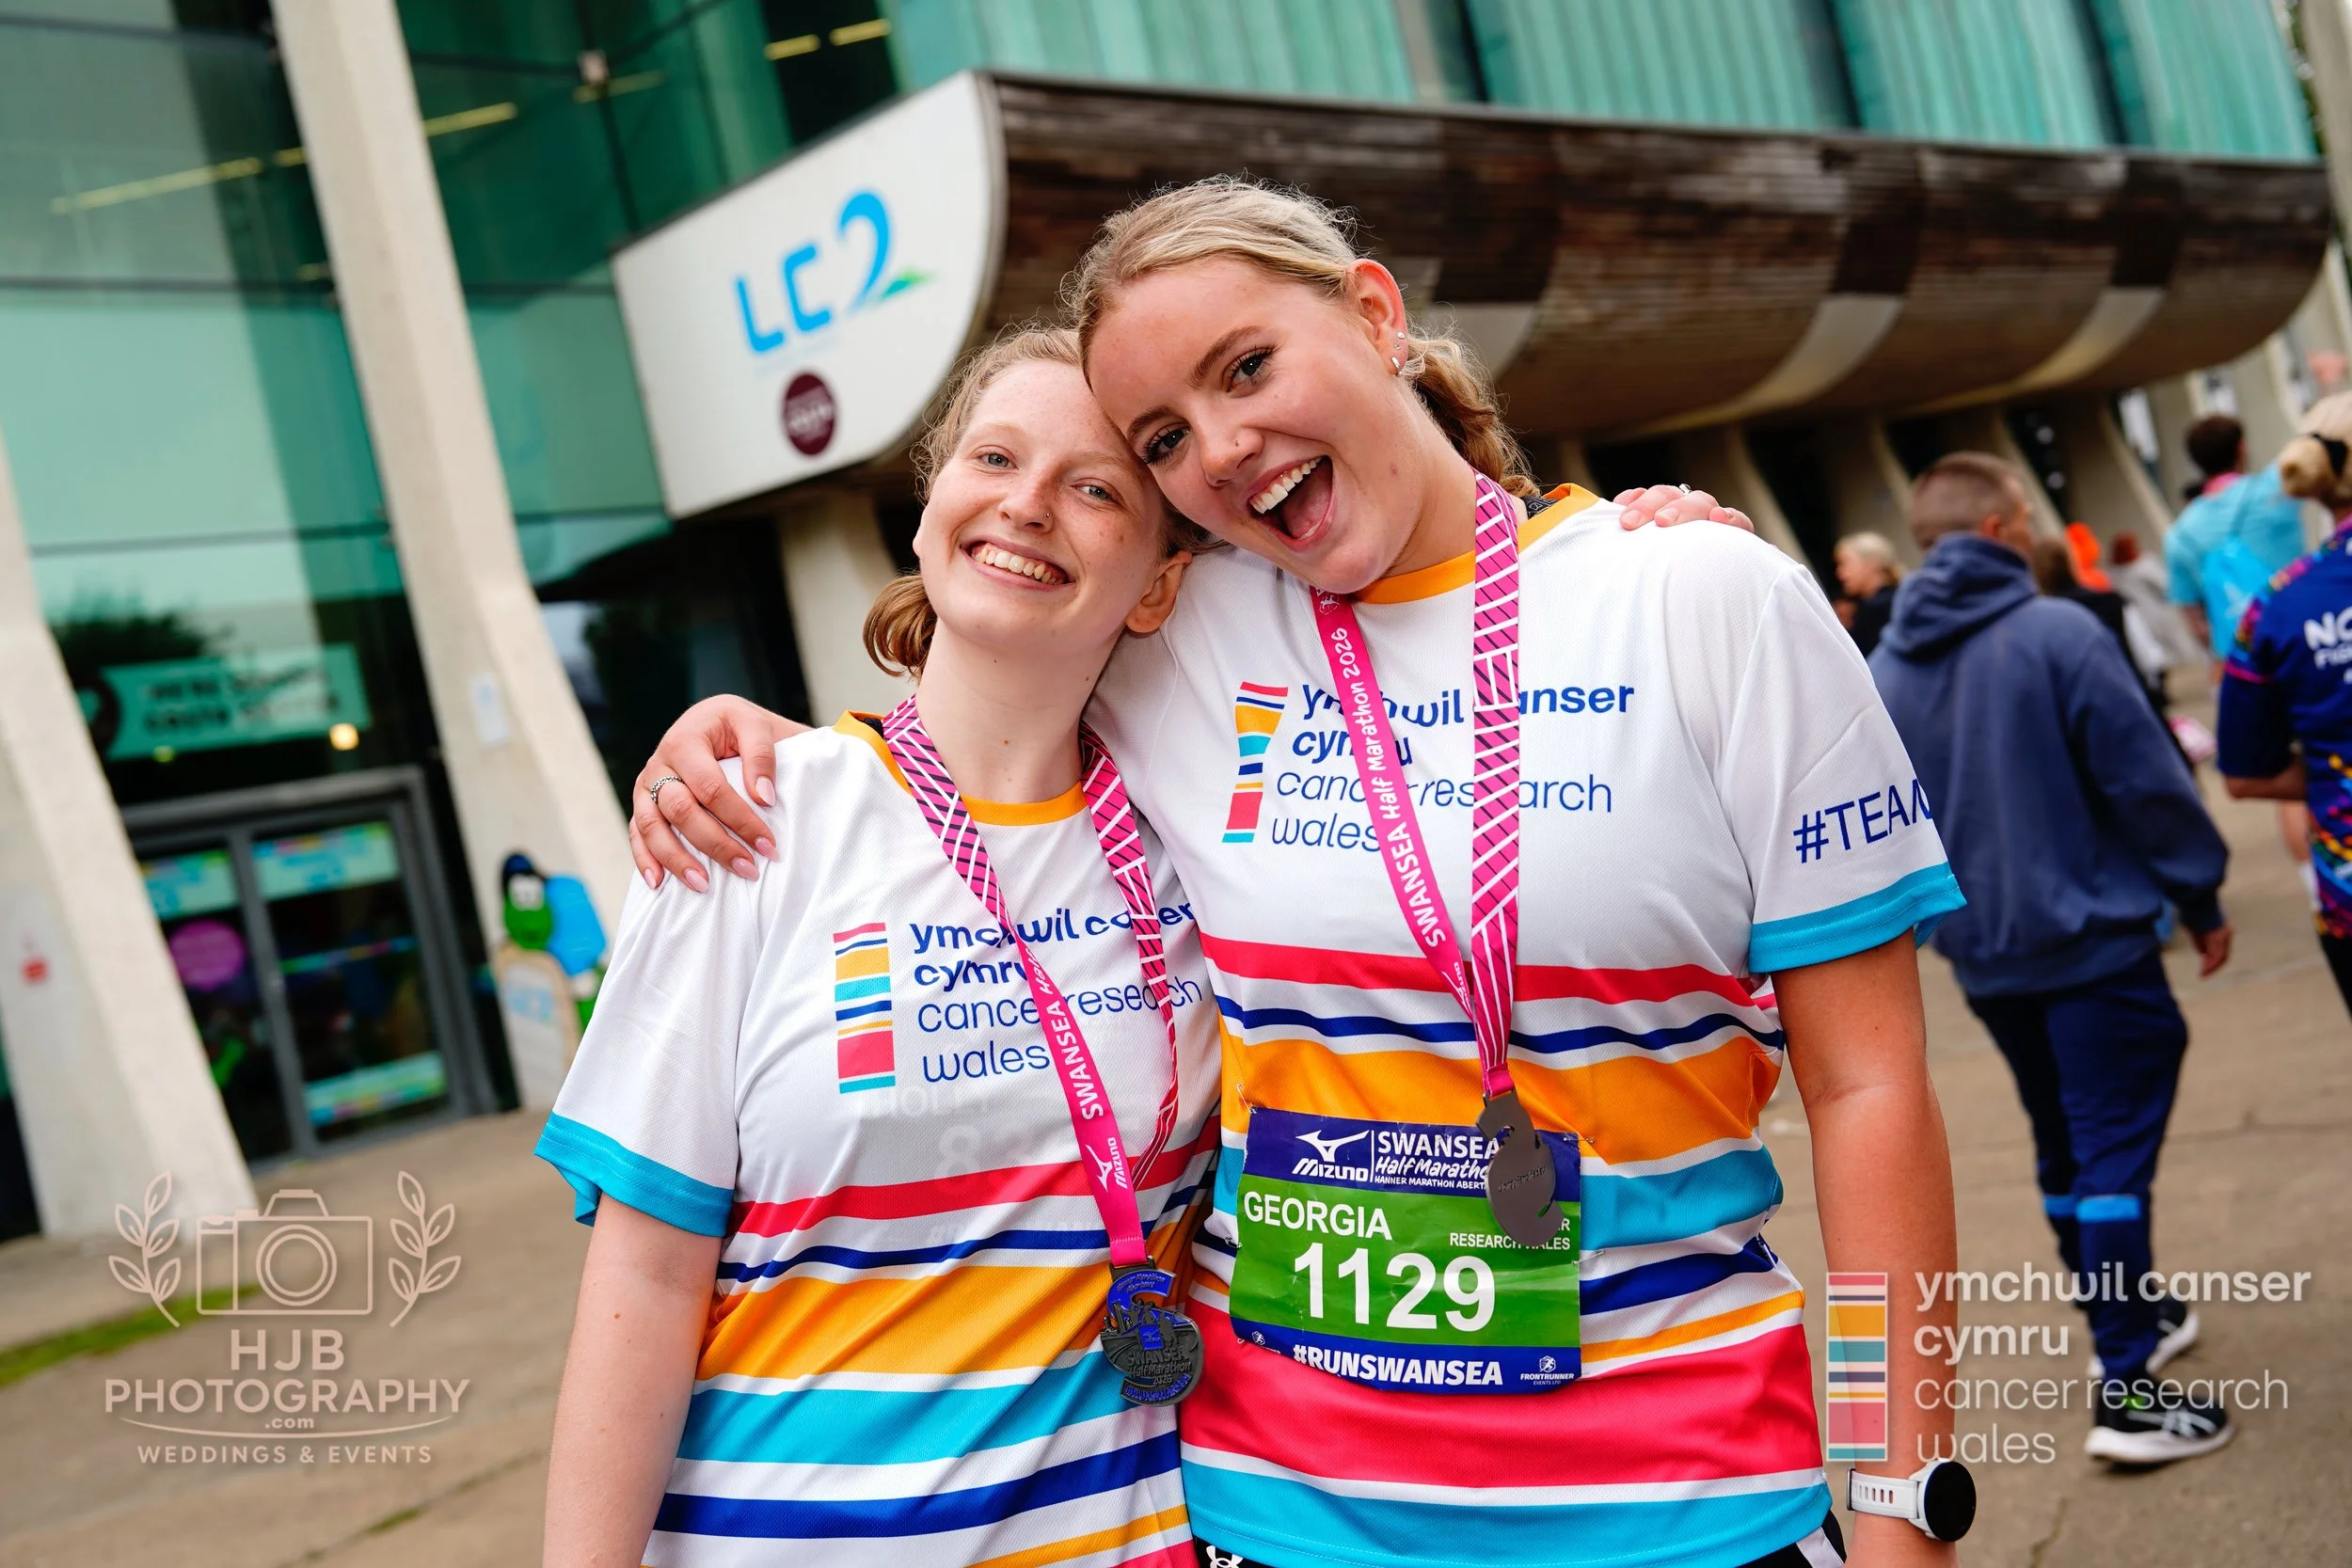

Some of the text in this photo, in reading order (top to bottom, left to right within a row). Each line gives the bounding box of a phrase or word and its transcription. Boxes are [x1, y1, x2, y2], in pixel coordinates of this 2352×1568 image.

[734, 188, 930, 354] LC2
[1292, 730, 1413, 767] cyu
[1277, 771, 1612, 813] canc resarch
[1330, 627, 1446, 947] SWANSEA Half Marathon 2026
[1272, 813, 1380, 852] wales
[1085, 902, 1195, 935] caer
[917, 997, 1041, 1033] cance
[923, 1040, 1051, 1083] wales
[1046, 1000, 1104, 1119] SWANSEA
[1377, 1131, 1500, 1160] SWANSEA
[1375, 1175, 1487, 1190] HANNER MARATHON ABERT
[1244, 1190, 1393, 1241] GEORGIA
[1294, 1242, 1496, 1333] 1129
[1129, 1345, 1189, 1367] SWANSEA
[1293, 1343, 1503, 1386] #RUNSWANSEA
